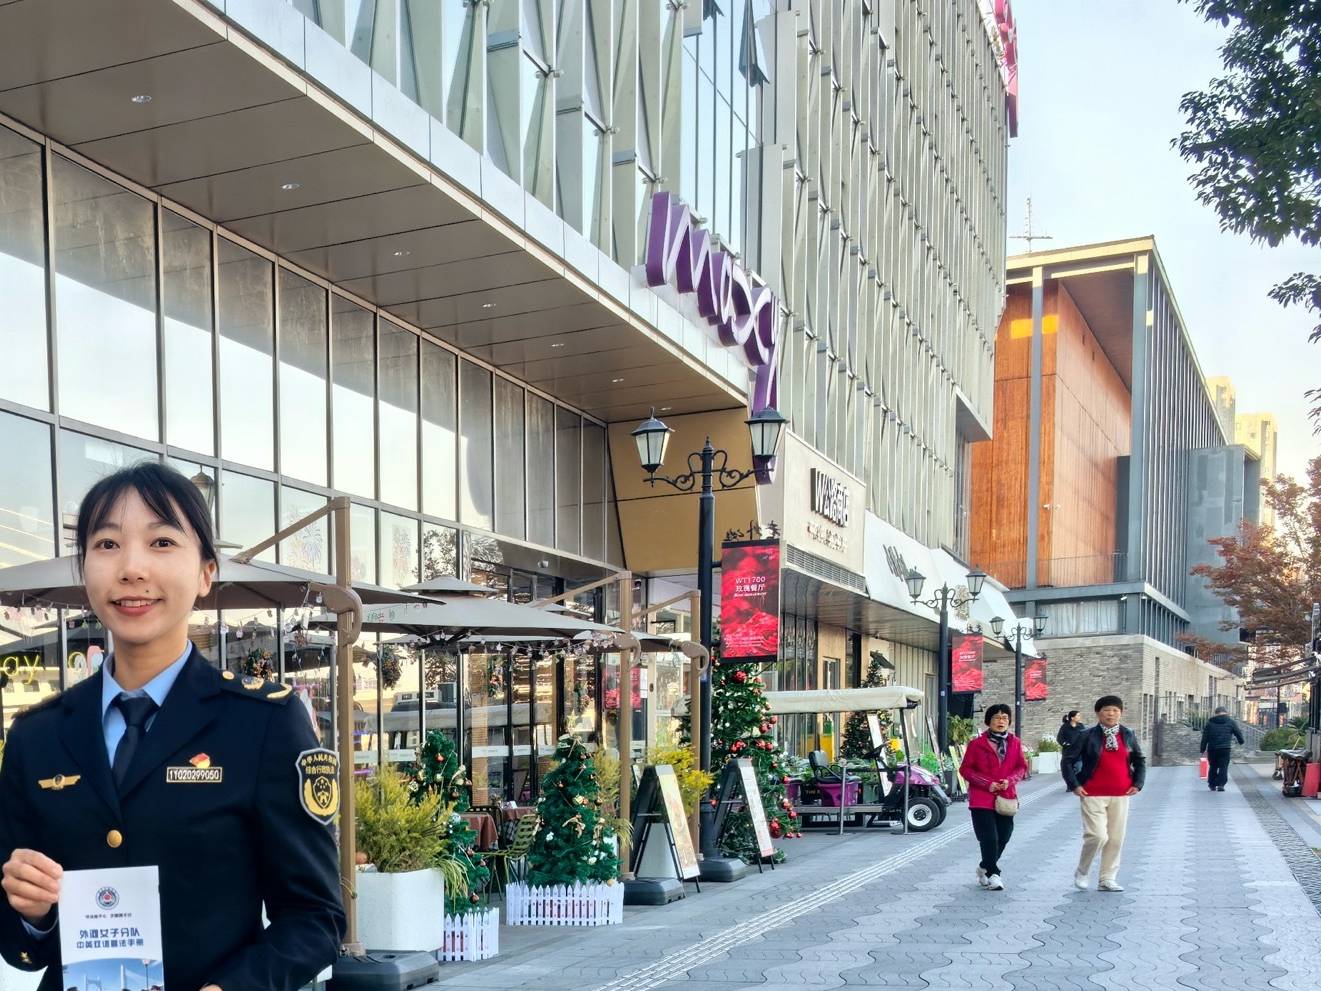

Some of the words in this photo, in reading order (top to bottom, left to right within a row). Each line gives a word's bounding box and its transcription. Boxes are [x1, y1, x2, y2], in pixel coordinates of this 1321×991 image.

[169, 769, 220, 780] 11020299050
[79, 927, 140, 939] 外滩女子分队
